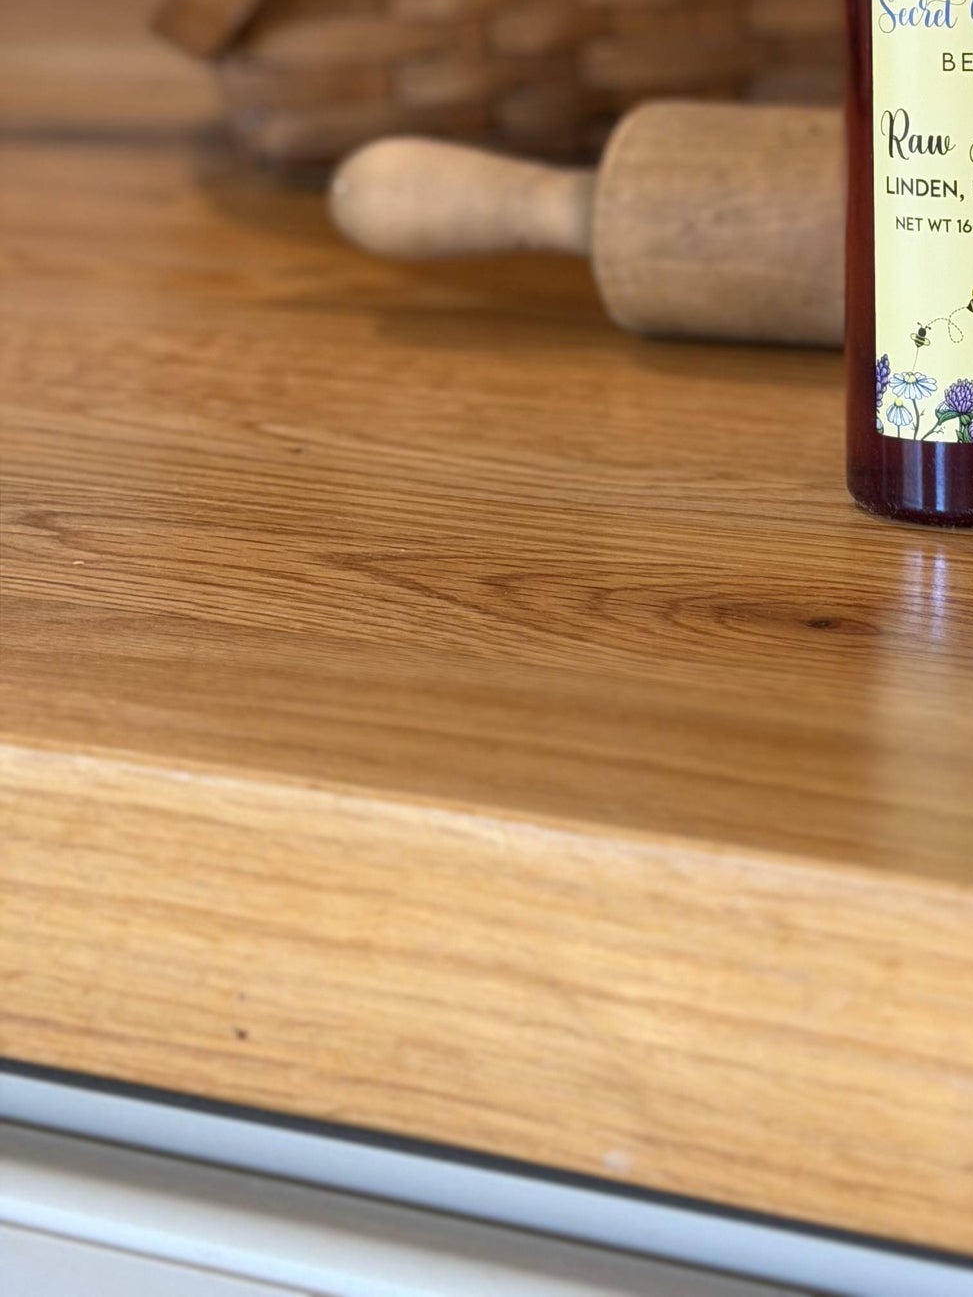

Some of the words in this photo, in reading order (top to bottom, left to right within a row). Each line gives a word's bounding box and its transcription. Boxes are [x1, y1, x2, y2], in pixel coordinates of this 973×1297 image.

[881, 108, 956, 160] Raw
[886, 175, 965, 202] LINDEN,
[895, 215, 924, 232] NET
[927, 218, 952, 233] WT
